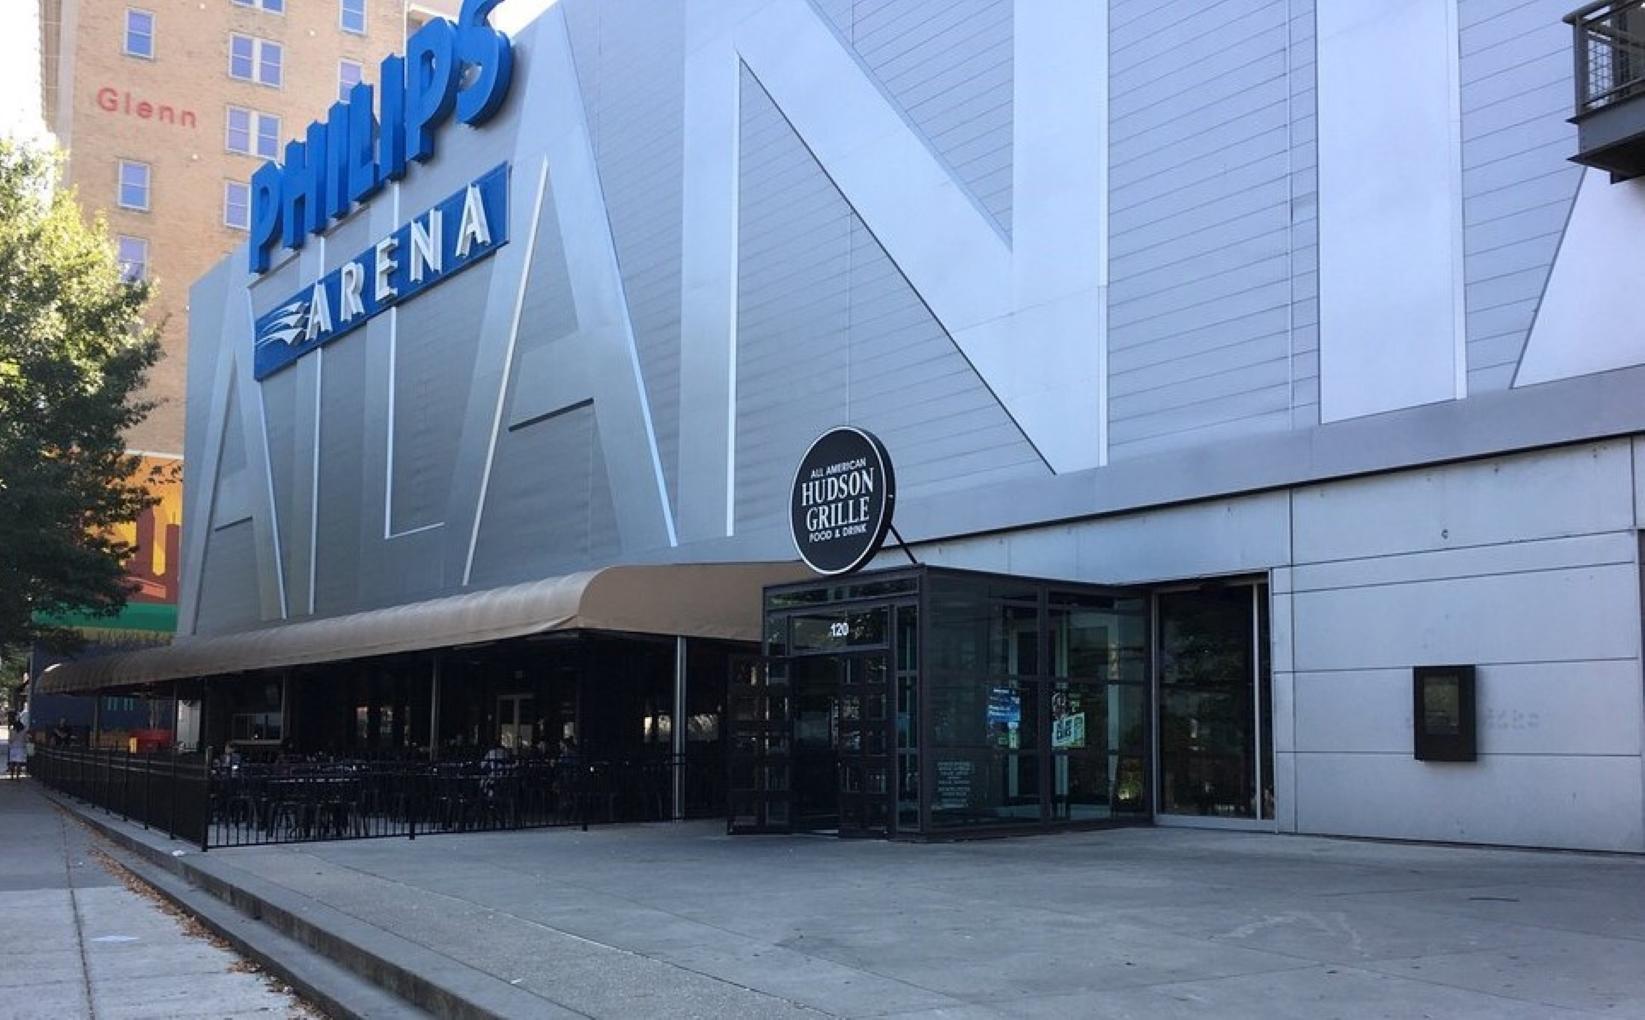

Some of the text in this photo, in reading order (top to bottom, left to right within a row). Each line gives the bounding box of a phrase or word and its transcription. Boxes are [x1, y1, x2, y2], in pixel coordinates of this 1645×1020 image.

[97, 87, 197, 129] Glenn
[249, 0, 513, 277] PHILIPS
[305, 184, 492, 341] ARENA
[801, 467, 874, 506] HUDSON
[811, 457, 867, 479] ALL AMERICAN
[806, 496, 870, 532] GRILLE
[808, 523, 867, 543] FOOD & DRINK
[830, 622, 849, 636] 120
